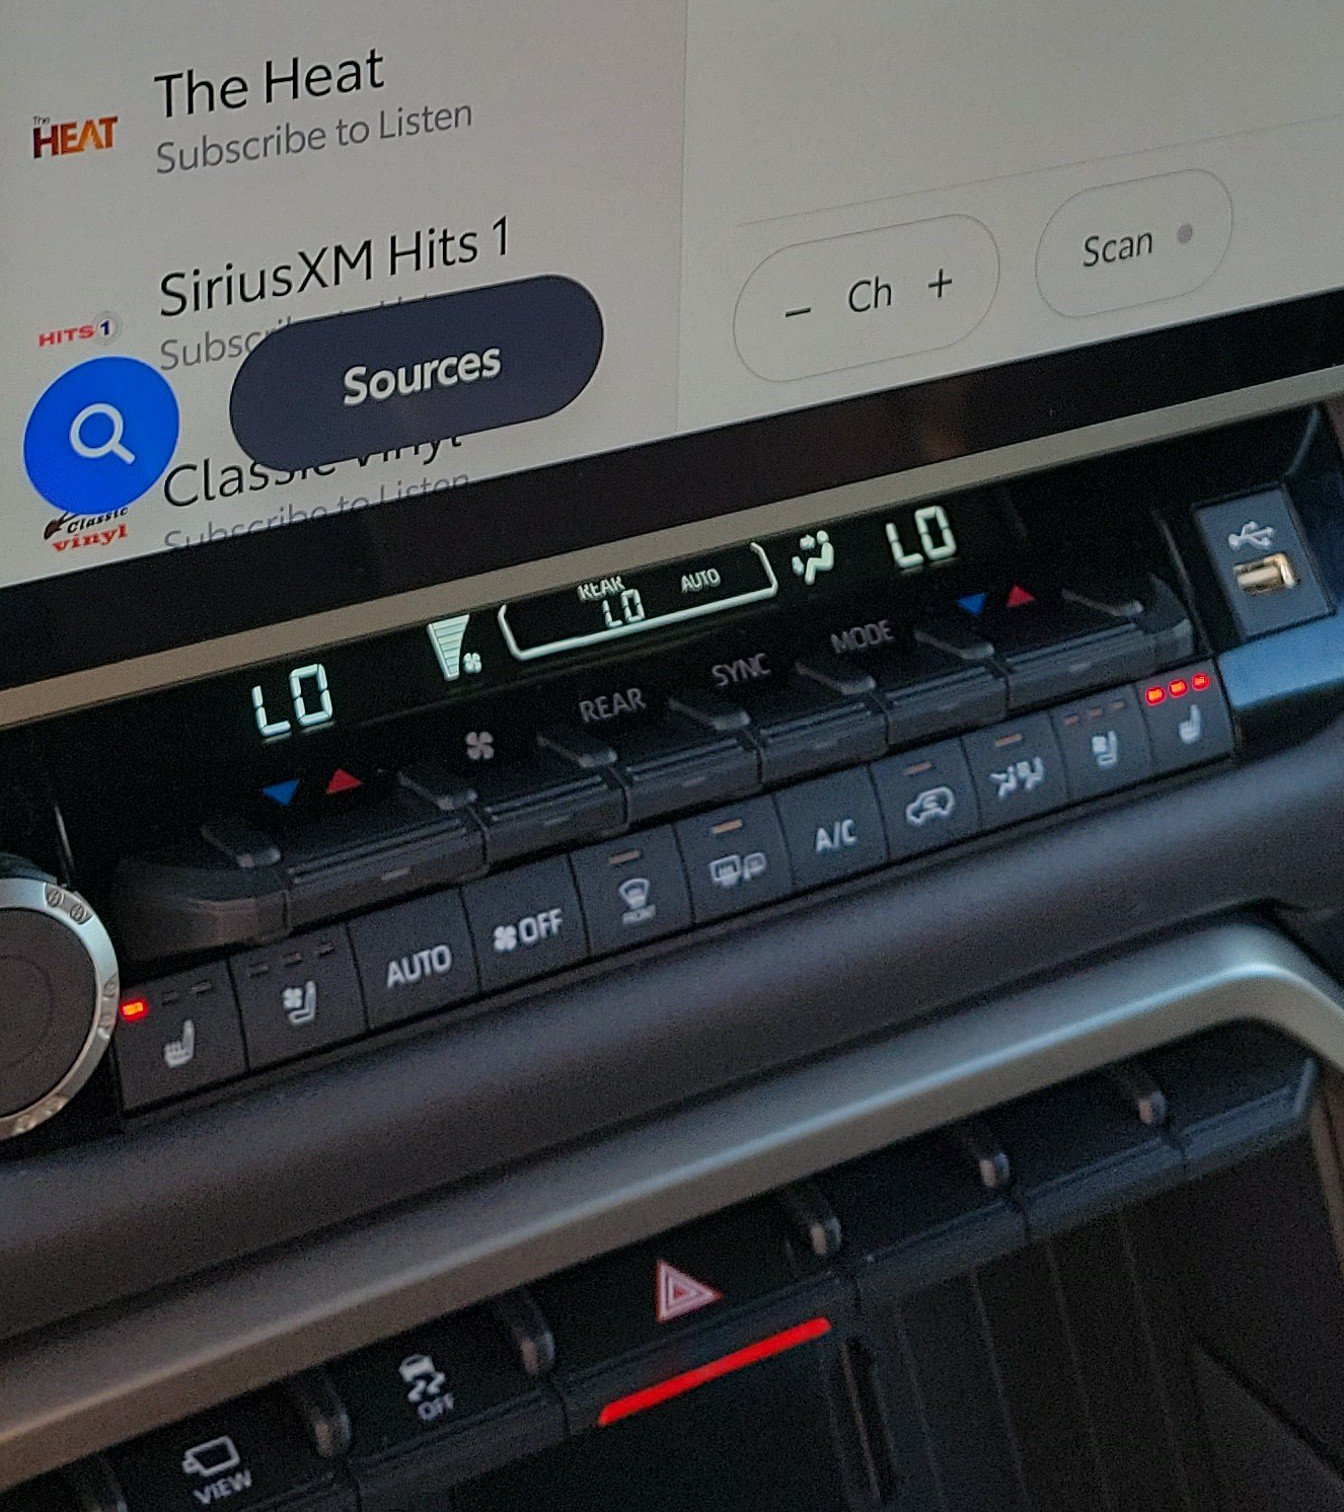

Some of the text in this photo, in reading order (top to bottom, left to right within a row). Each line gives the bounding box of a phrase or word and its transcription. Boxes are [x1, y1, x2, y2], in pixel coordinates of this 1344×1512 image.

[154, 49, 384, 117] The Heat
[33, 115, 119, 159] HEAT
[157, 105, 471, 174] Subscribe to Listen
[160, 217, 506, 316] SiriusXM Hits 1
[1084, 233, 1152, 267] Scan
[849, 276, 891, 312] Ch
[37, 319, 111, 348] HITS 1
[159, 316, 291, 371] Subsc
[344, 349, 500, 405] Sources
[52, 522, 128, 552] vinyl
[66, 507, 129, 534] Classic
[884, 504, 956, 567] LO
[680, 566, 722, 594] AUTO
[831, 620, 893, 653] MODE
[712, 653, 770, 686] SYNC
[252, 664, 332, 737] LO
[579, 688, 646, 722] REAR
[817, 820, 855, 851] A/C
[519, 909, 562, 943] OFF
[388, 945, 451, 987] AUTO
[193, 1467, 252, 1503] VIEW
